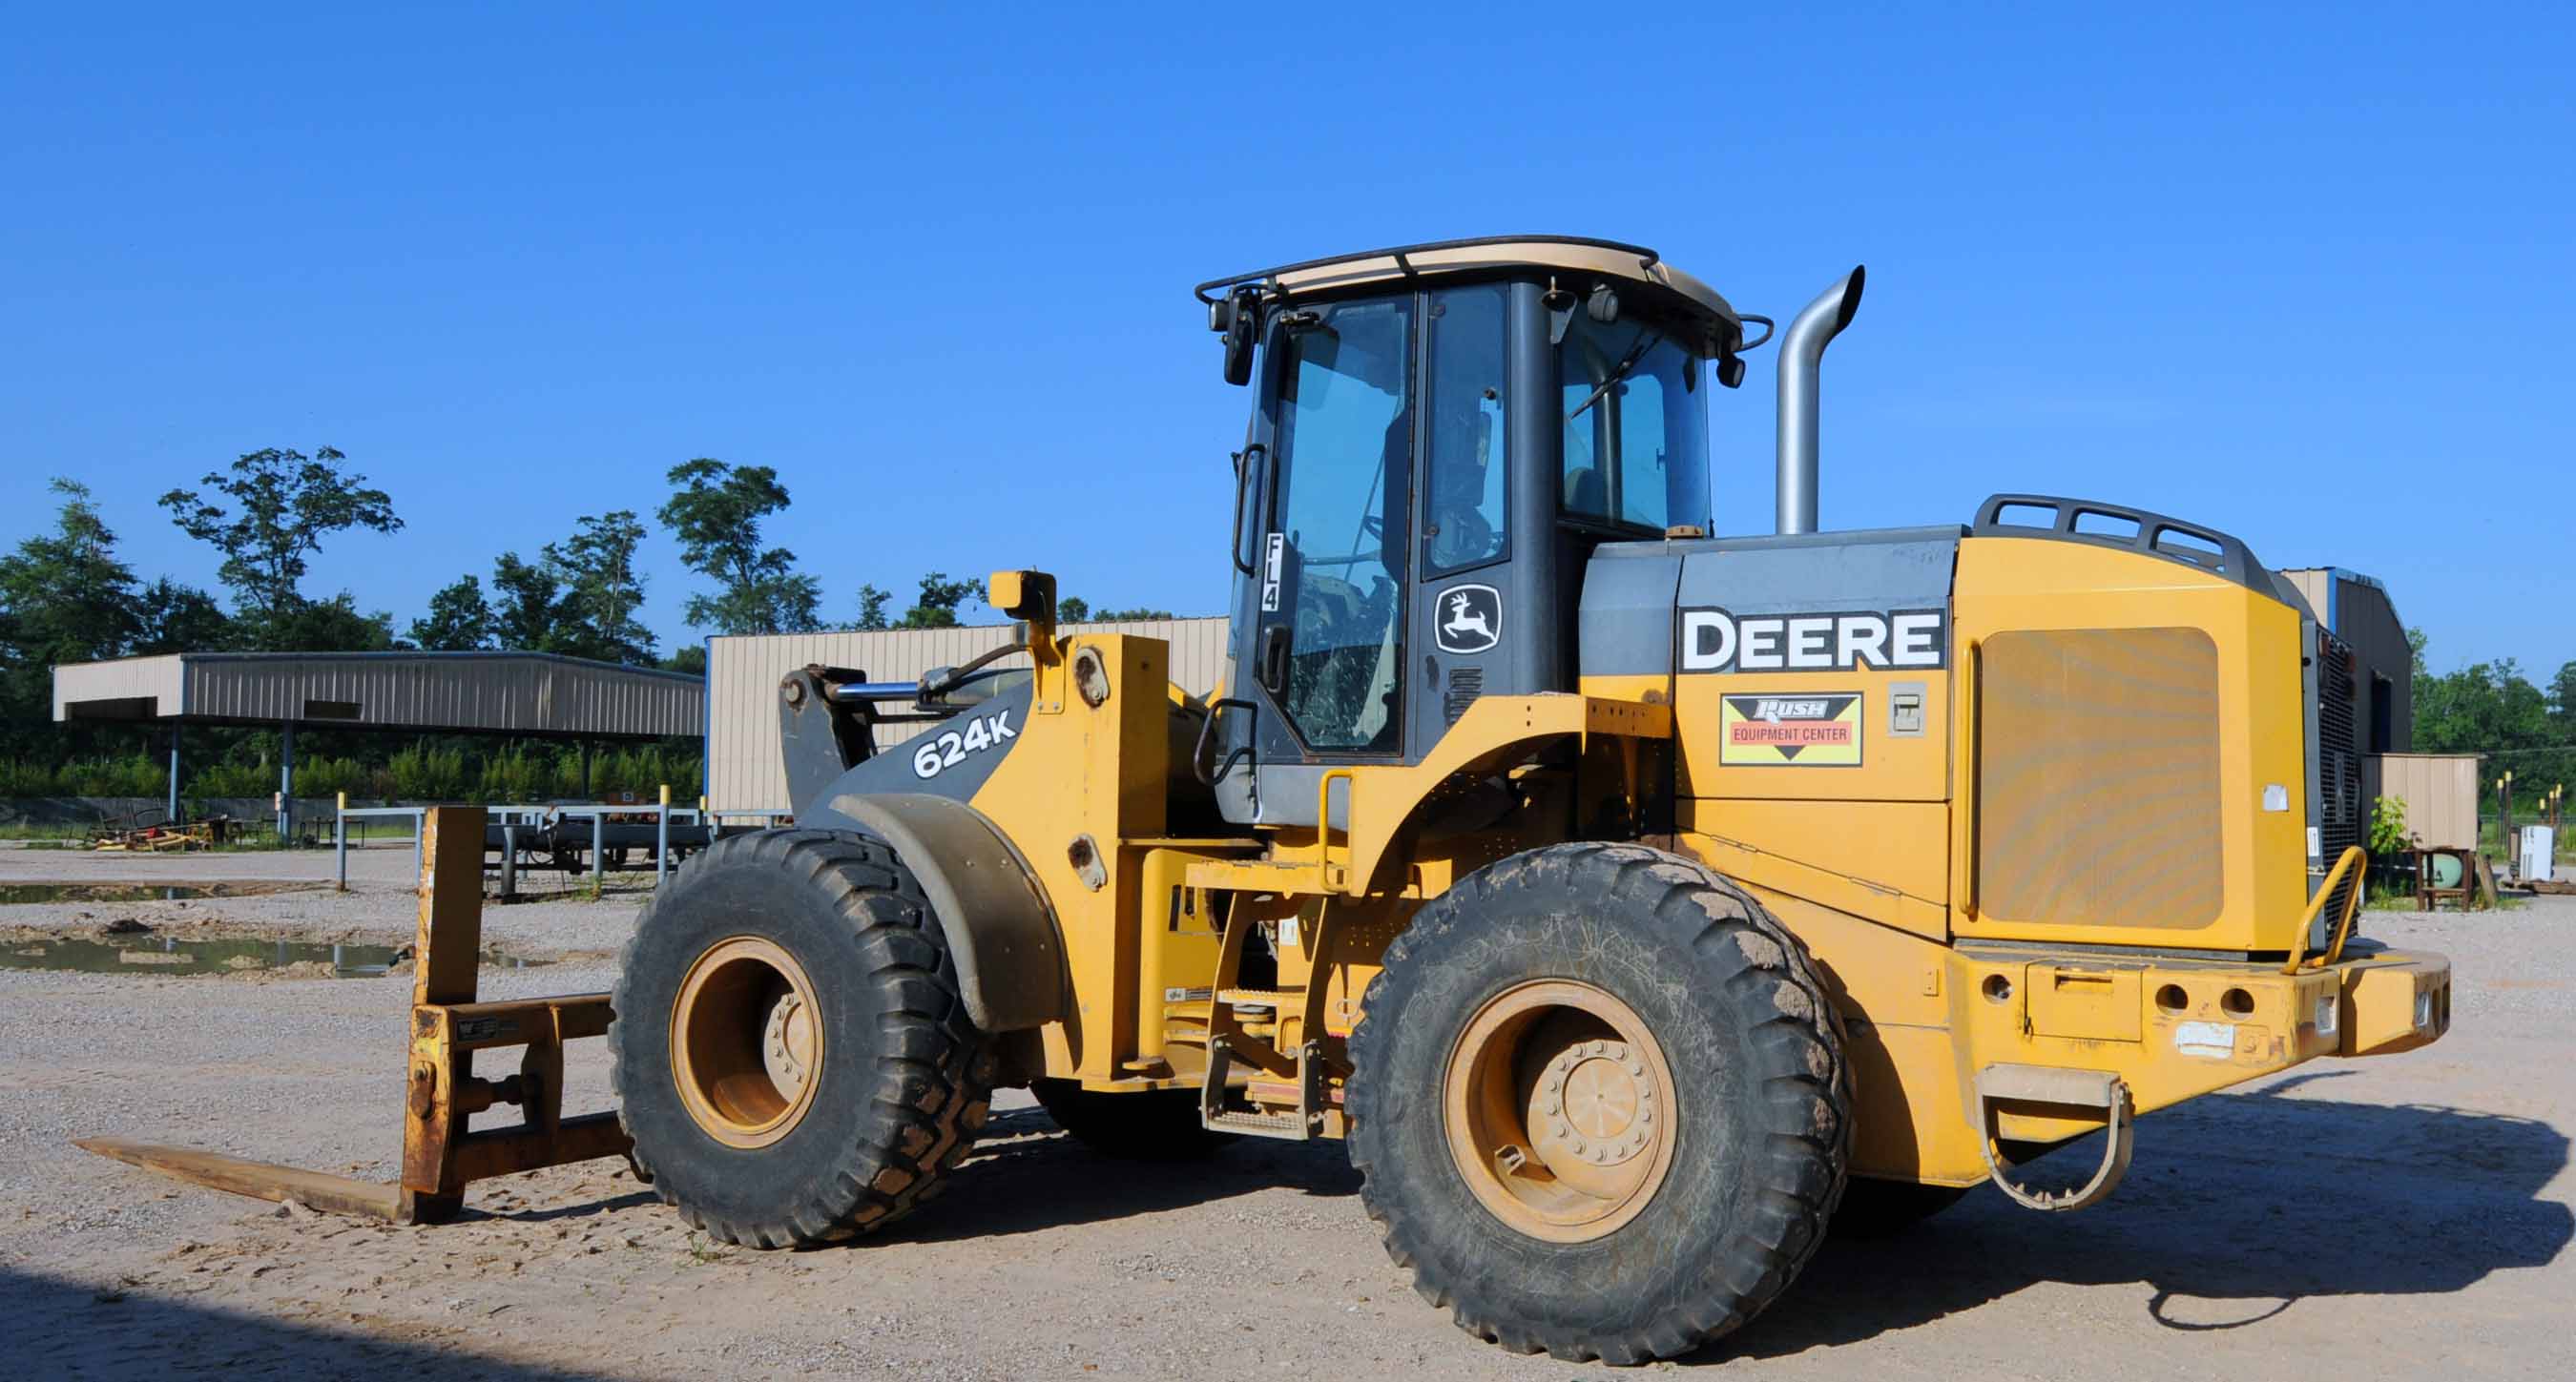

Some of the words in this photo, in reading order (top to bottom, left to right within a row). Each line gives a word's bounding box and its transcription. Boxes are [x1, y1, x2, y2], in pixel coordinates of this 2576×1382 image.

[1682, 610, 1942, 670] DEERE
[1754, 700, 1828, 725] RUSH
[913, 709, 1017, 778] 624K
[1734, 728, 1798, 741] EQUIPMENT
[1802, 728, 1847, 741] CENTER
